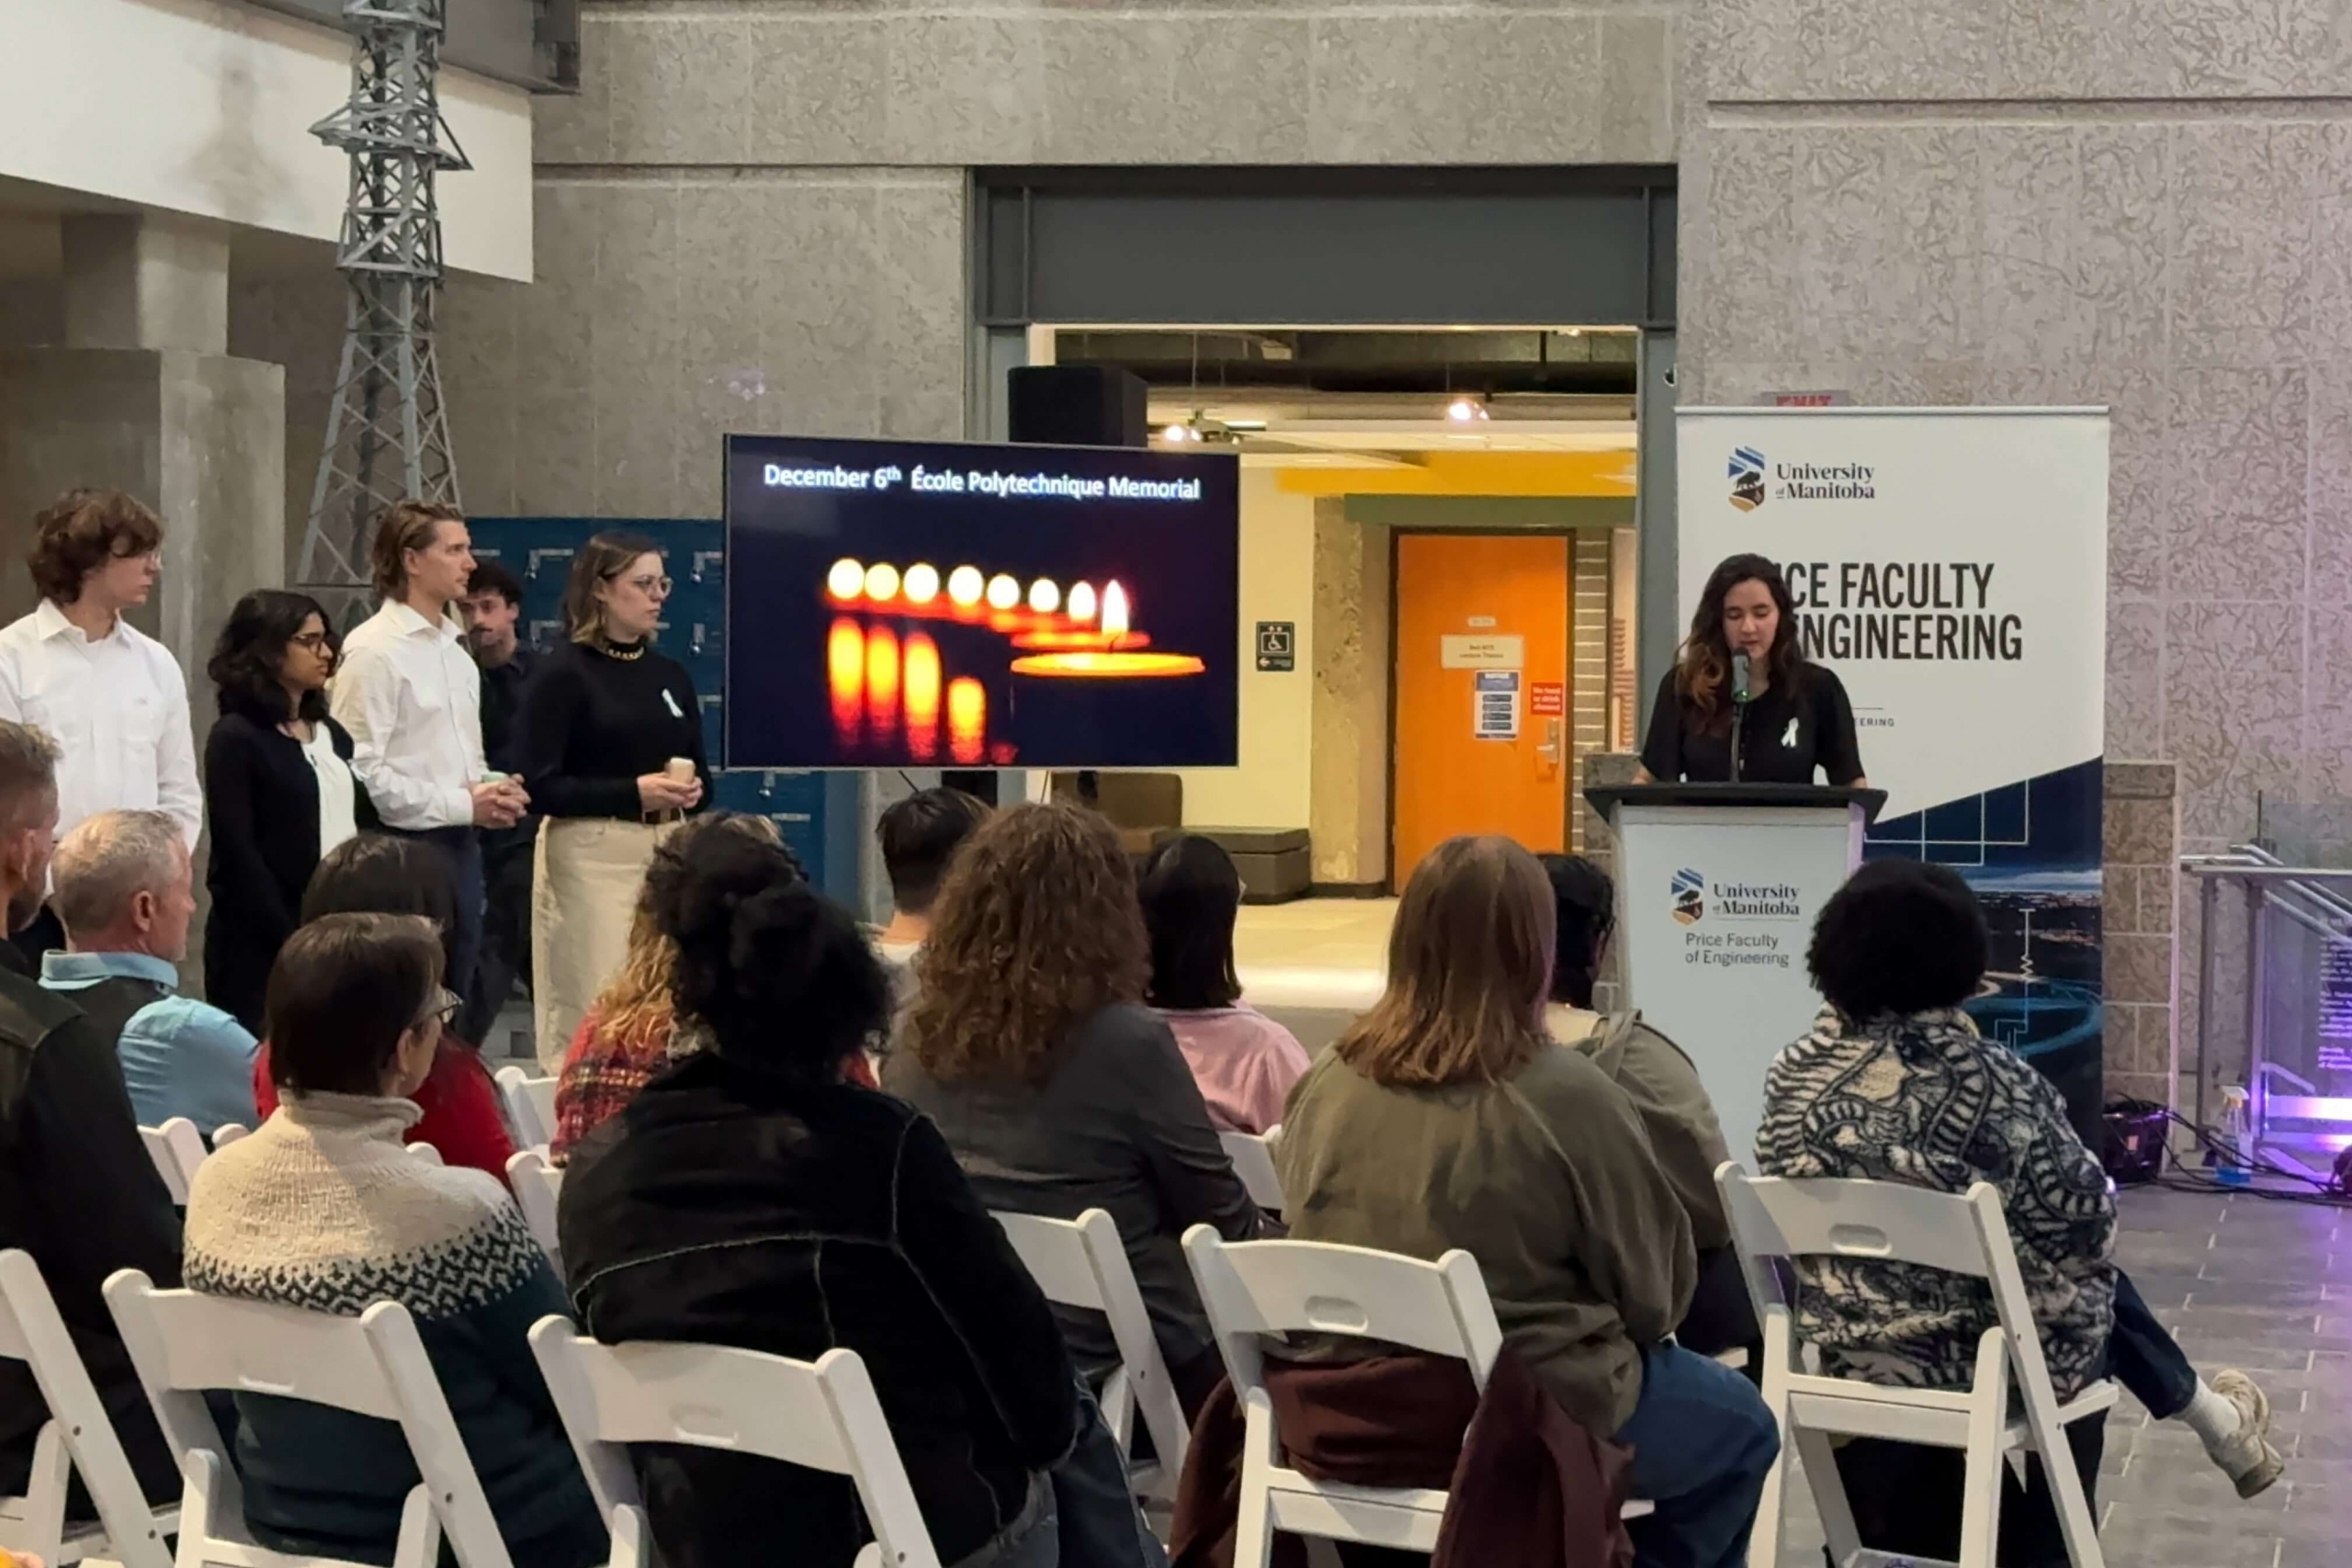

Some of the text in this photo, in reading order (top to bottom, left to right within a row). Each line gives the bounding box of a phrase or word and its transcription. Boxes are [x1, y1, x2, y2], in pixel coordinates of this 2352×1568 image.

[764, 464, 870, 488] December
[910, 464, 964, 491] École
[968, 470, 1104, 500] Polytechnique
[1109, 475, 1201, 499] Memorial
[1777, 463, 1875, 484] University
[1787, 481, 1875, 499] Manitoba
[1840, 562, 1995, 609] FACULTY
[1794, 614, 2022, 660] NGINEERING
[1713, 883, 1800, 902] University
[1723, 900, 1800, 916] Manitoba
[1686, 932, 1779, 950] Price Faculty
[1685, 950, 1790, 968] of Engineering
